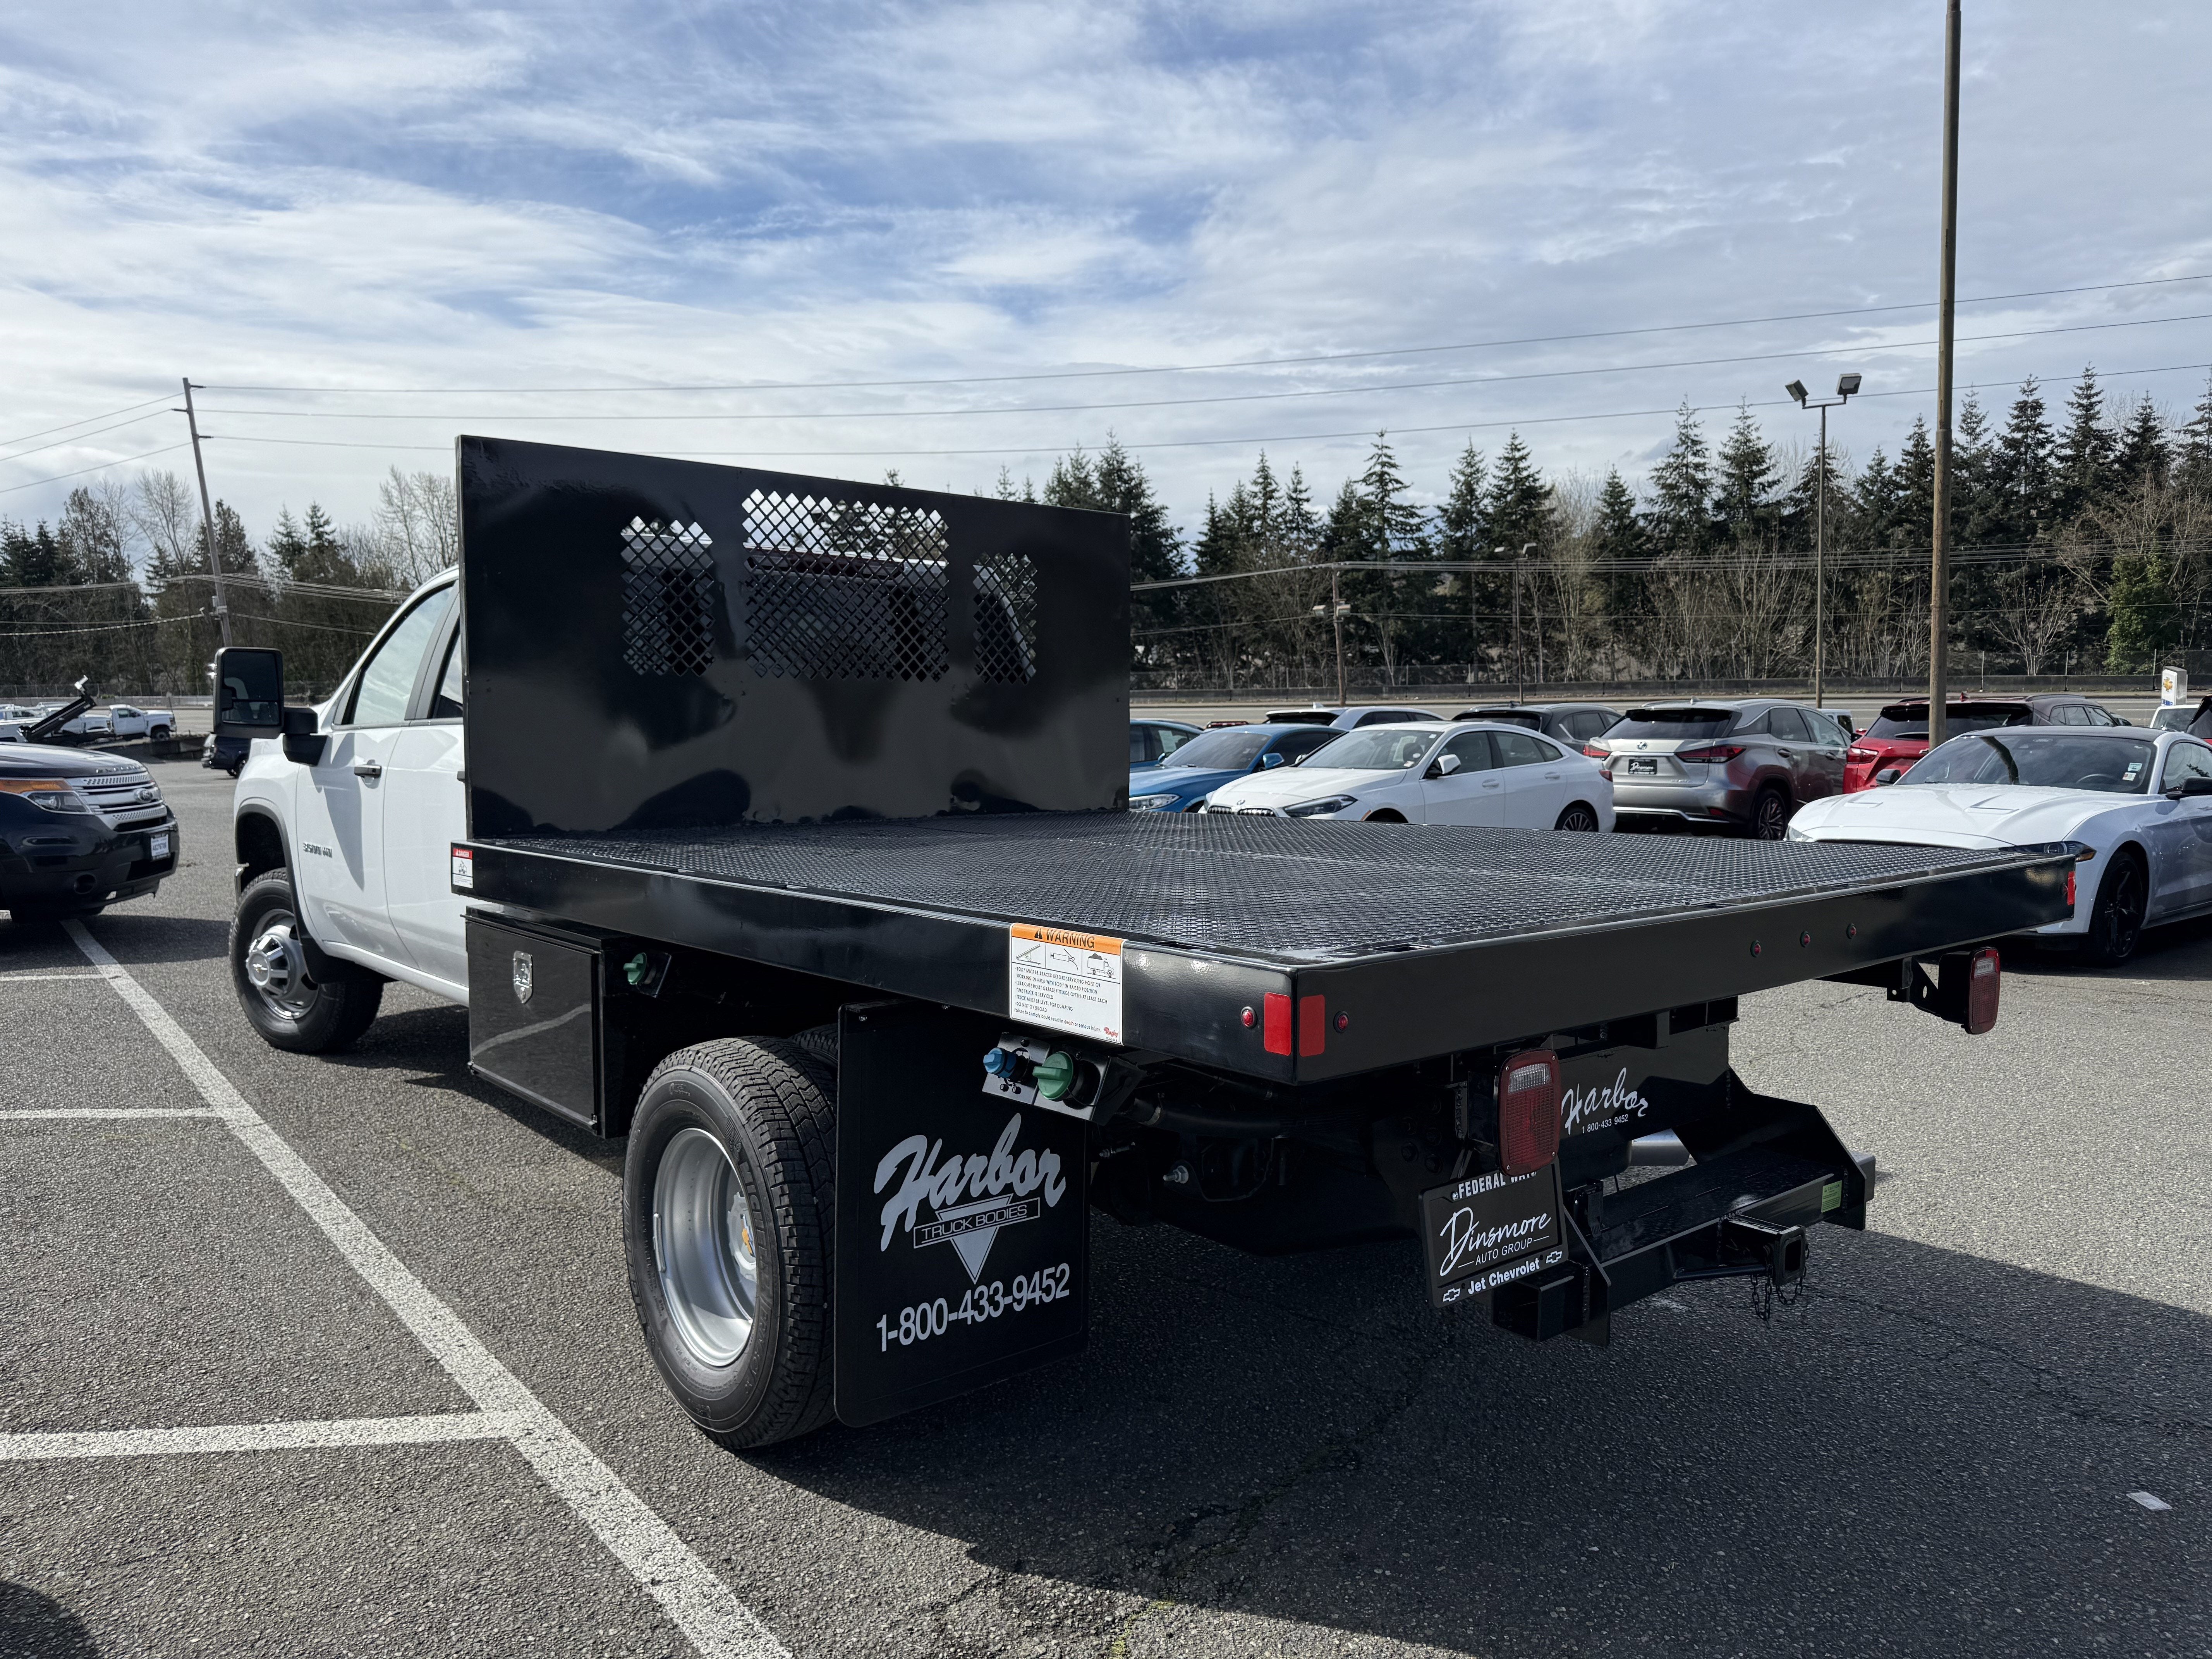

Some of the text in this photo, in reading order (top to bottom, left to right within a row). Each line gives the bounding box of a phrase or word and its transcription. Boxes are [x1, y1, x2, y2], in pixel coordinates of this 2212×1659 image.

[1046, 929, 1095, 948] WARNING
[1561, 1067, 1648, 1135] Harbor
[874, 1113, 1066, 1252] Harbor
[1458, 1172, 1506, 1199] FEDERAL
[921, 1205, 1027, 1240] TRUCK BODIES
[1439, 1207, 1551, 1277] Dinsmore
[1475, 1237, 1533, 1266] AUTO GROUP
[1468, 1258, 1540, 1295] Jet Chevrolet
[876, 1263, 1070, 1352] 1-800-433-9452
